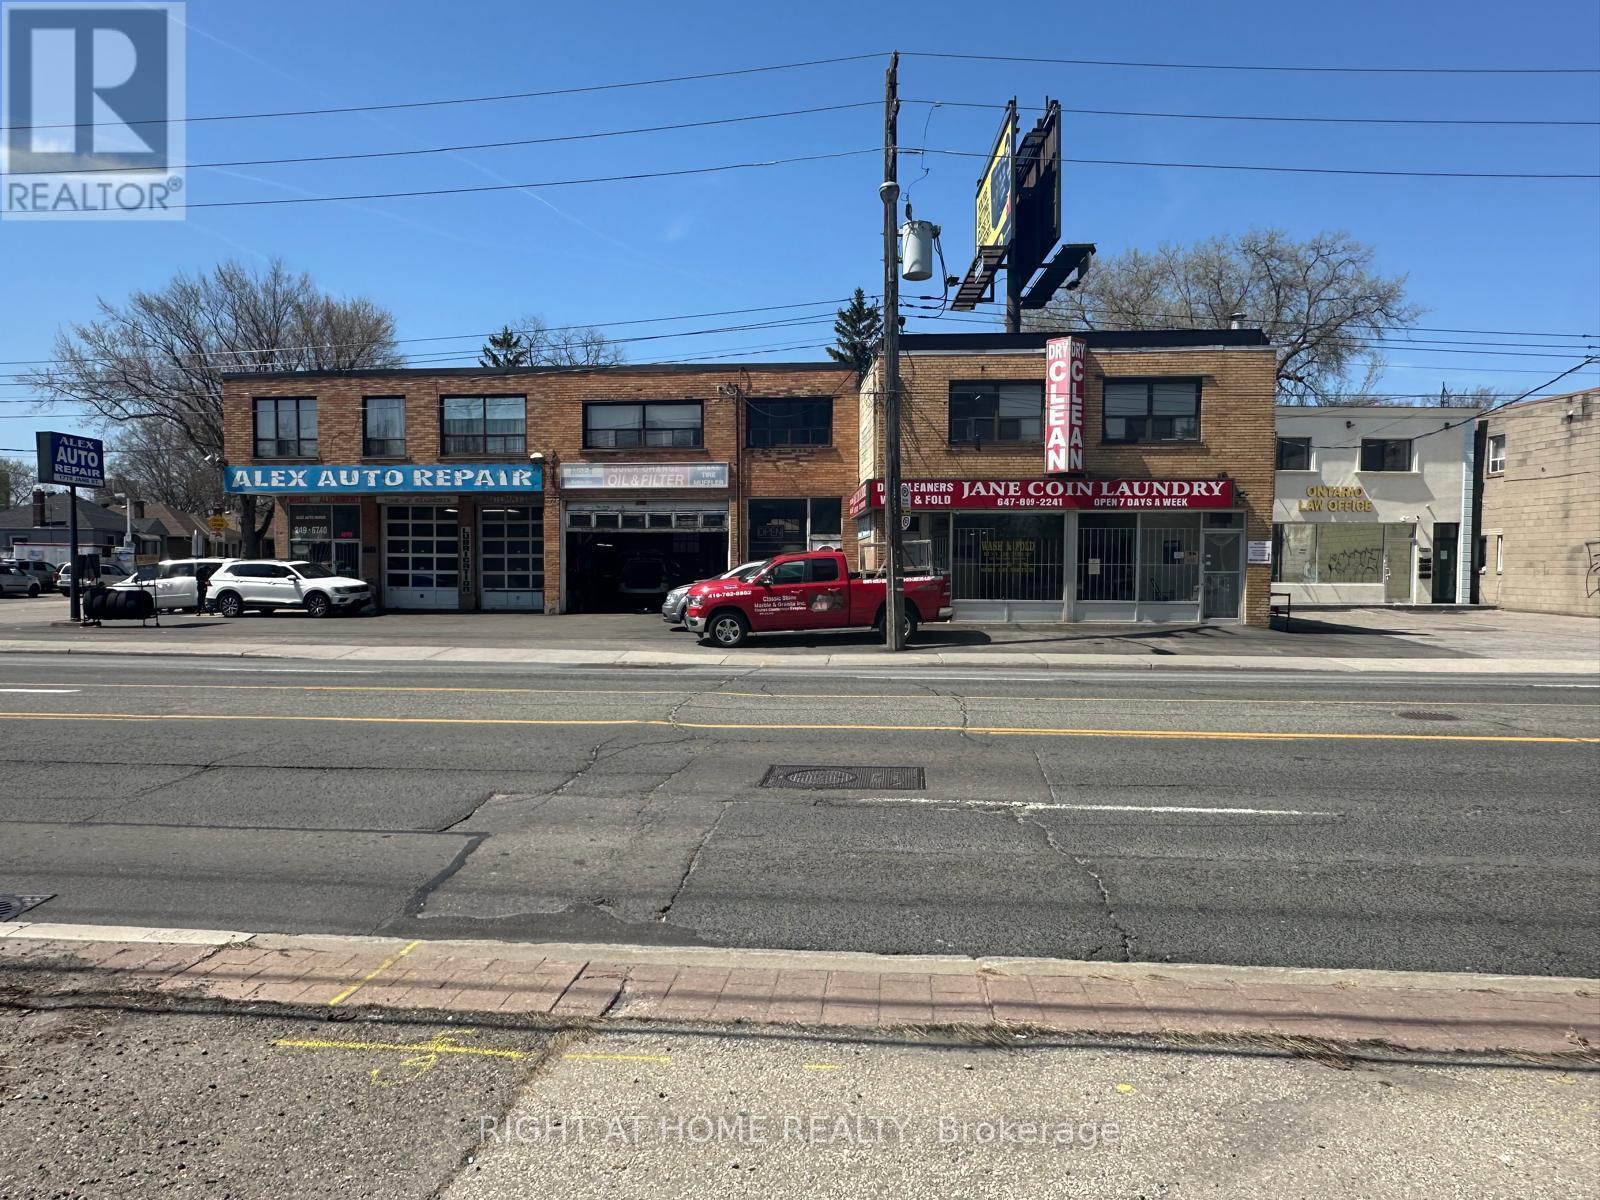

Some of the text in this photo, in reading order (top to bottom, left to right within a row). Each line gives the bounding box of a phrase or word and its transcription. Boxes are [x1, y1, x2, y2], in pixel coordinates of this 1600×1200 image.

[1048, 341, 1068, 360] DRY
[1071, 340, 1085, 359] DRY
[1047, 361, 1067, 470] CLEAN
[1070, 360, 1083, 470] CLEAN
[60, 436, 94, 450] ALEX
[56, 446, 99, 468] AUTO
[54, 464, 101, 478] REPAIR
[231, 469, 532, 488] ALEX AUTO REPAIR
[961, 481, 1226, 499] JANE COIN LAUNDRY
[1306, 485, 1363, 498] ONTARIO
[914, 495, 922, 504] &
[925, 495, 951, 504] FOLD
[1094, 498, 1188, 506] OPEN 7 DAYS A WEEK
[1298, 499, 1373, 512] LAW OFFICE
